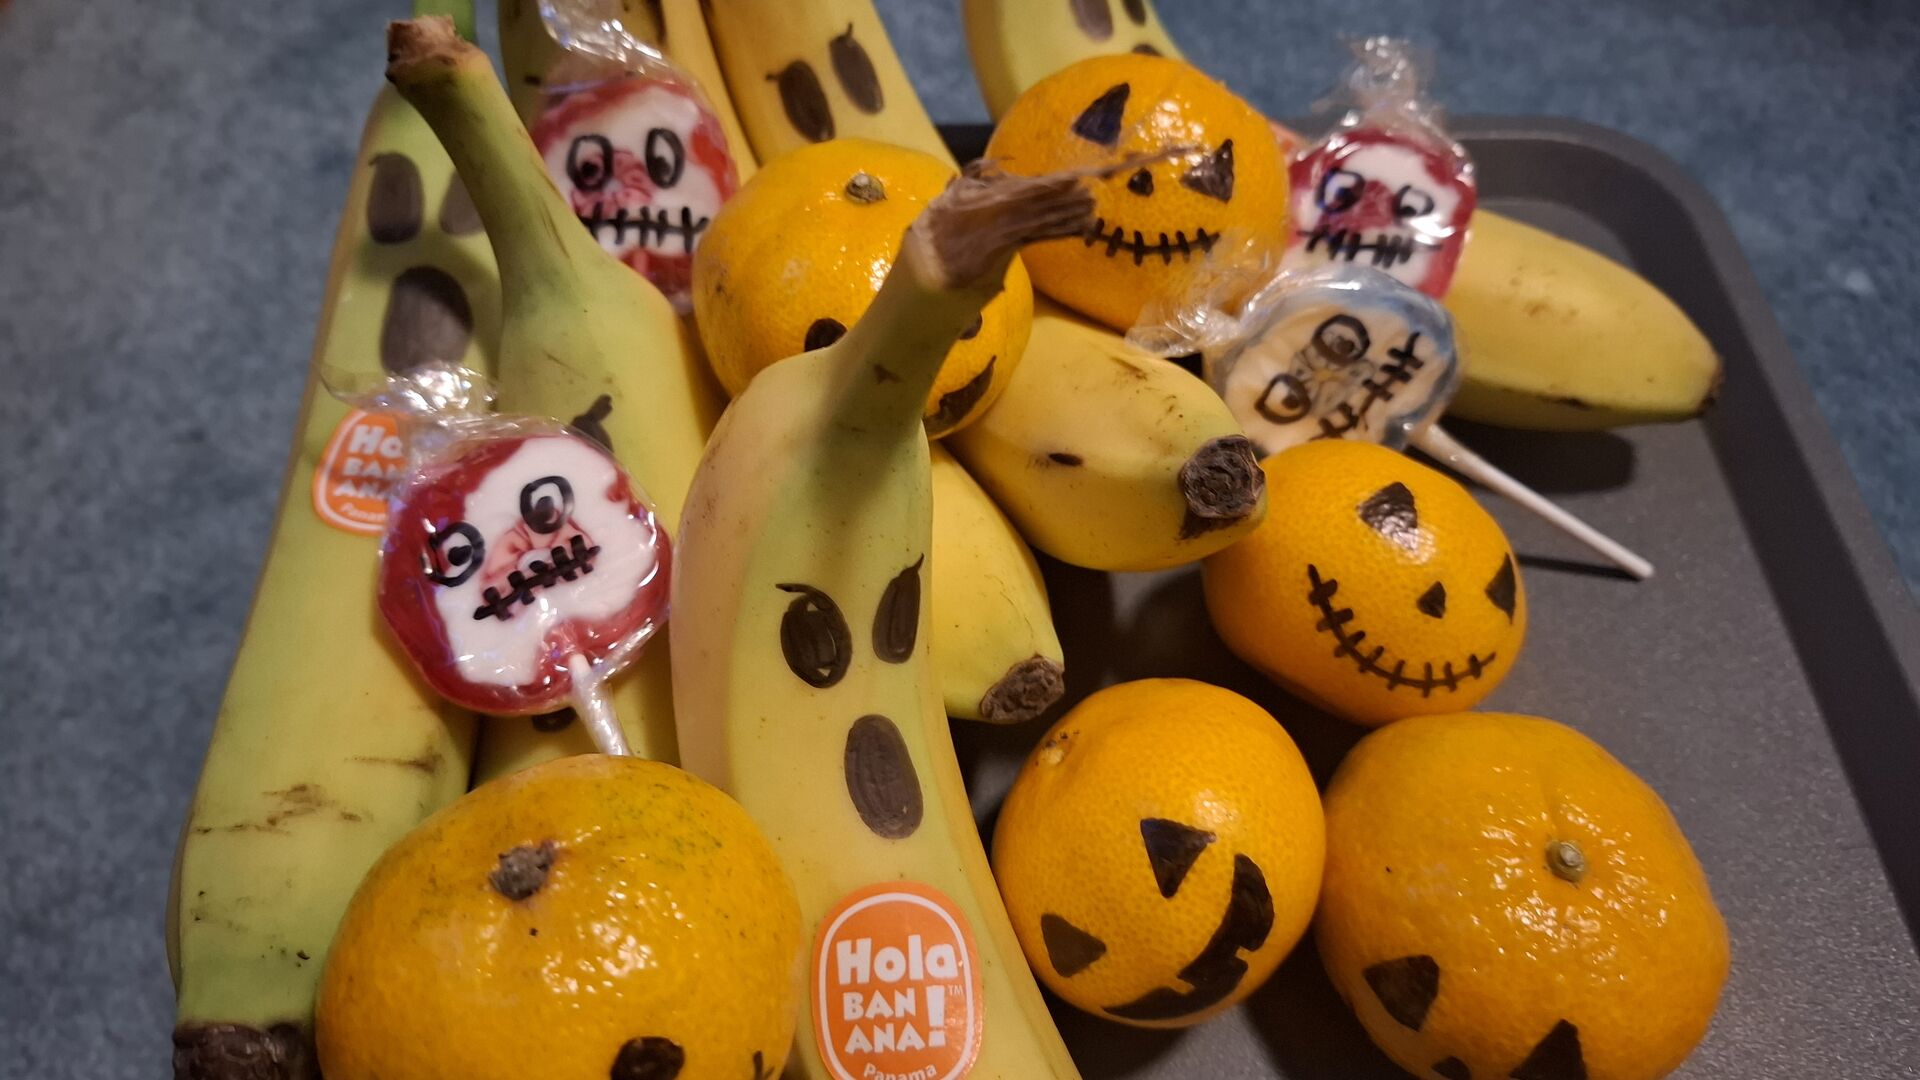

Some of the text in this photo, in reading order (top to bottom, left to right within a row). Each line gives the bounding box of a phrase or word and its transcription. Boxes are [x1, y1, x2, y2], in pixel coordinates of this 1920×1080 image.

[348, 424, 403, 459] Ho
[836, 934, 958, 985] Hola
[843, 988, 916, 1021] BAN
[863, 1062, 937, 1080] Panama
